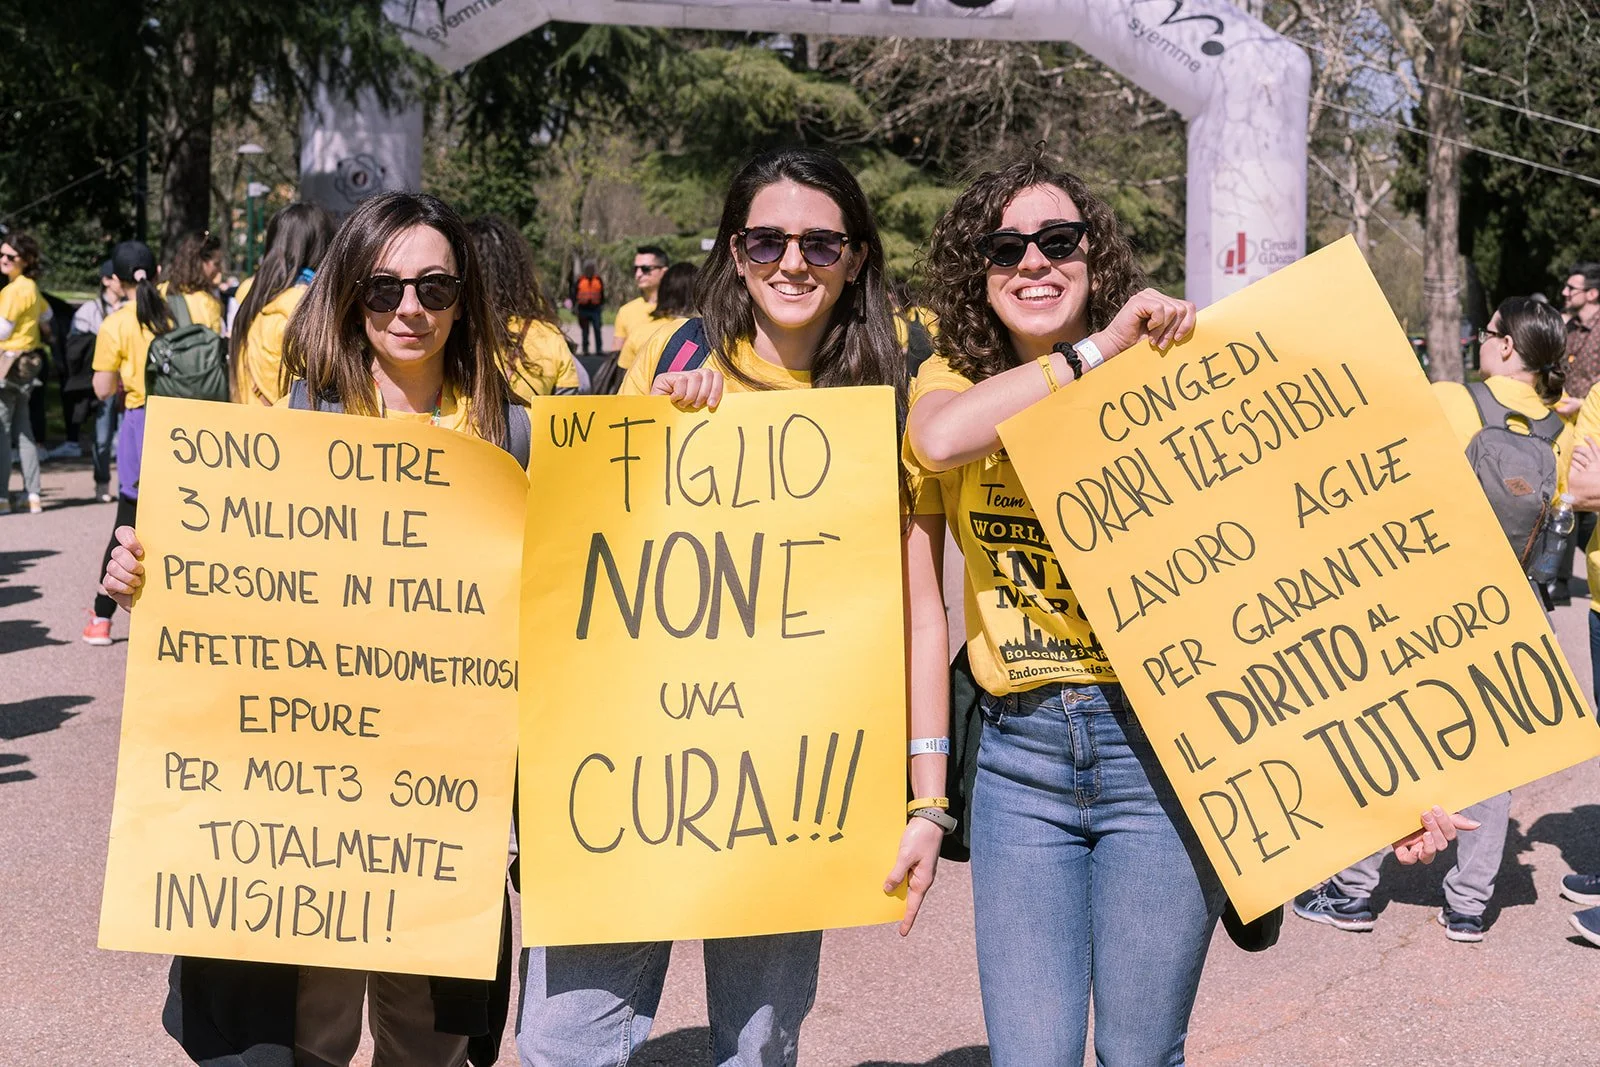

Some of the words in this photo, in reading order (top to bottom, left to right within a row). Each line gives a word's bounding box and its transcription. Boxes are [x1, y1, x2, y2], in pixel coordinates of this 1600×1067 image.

[426, 0, 501, 41] syemm
[1128, 17, 1201, 73] syemme
[1100, 332, 1278, 442] CONGEDI
[171, 428, 279, 471] SONO
[329, 440, 449, 486] OLTRE
[551, 411, 595, 447] UN
[609, 414, 830, 512] FIGLIO
[1057, 448, 1174, 552] ORARI
[1160, 364, 1368, 491] FLESSIBILI
[179, 487, 209, 531] 3
[222, 497, 356, 540] MILIONI
[383, 511, 427, 547] LE
[980, 483, 1026, 508] Team
[1108, 522, 1256, 632] LAVORO
[1295, 438, 1412, 529] AGILE
[164, 555, 318, 603] PERSONE
[344, 573, 372, 606] IN
[390, 579, 484, 614] ITALIA
[577, 531, 764, 640] NON
[1143, 638, 1216, 695] PER
[1233, 509, 1450, 645] GARANTIRE
[1368, 604, 1399, 632] AL
[1381, 585, 1510, 676] LAVORO
[159, 627, 279, 670] AFFETTE
[286, 638, 326, 670] DA
[337, 644, 518, 692] ENDOMETRIOSI
[1005, 649, 1068, 660] BOLOGNA
[1070, 648, 1085, 659] 23
[661, 682, 743, 719] UNA
[1206, 625, 1368, 745] DIRITTO
[240, 696, 380, 737] EPPURE
[166, 752, 221, 792] PER
[245, 758, 362, 801] MOLT3
[390, 771, 477, 811] SONO
[1174, 733, 1216, 773] IL
[1199, 760, 1323, 876] PER
[1468, 634, 1585, 748] NOI
[570, 730, 864, 853] CURA!!!
[199, 822, 462, 881] TOTALMENTE
[155, 873, 394, 942] INVISIBILI!
